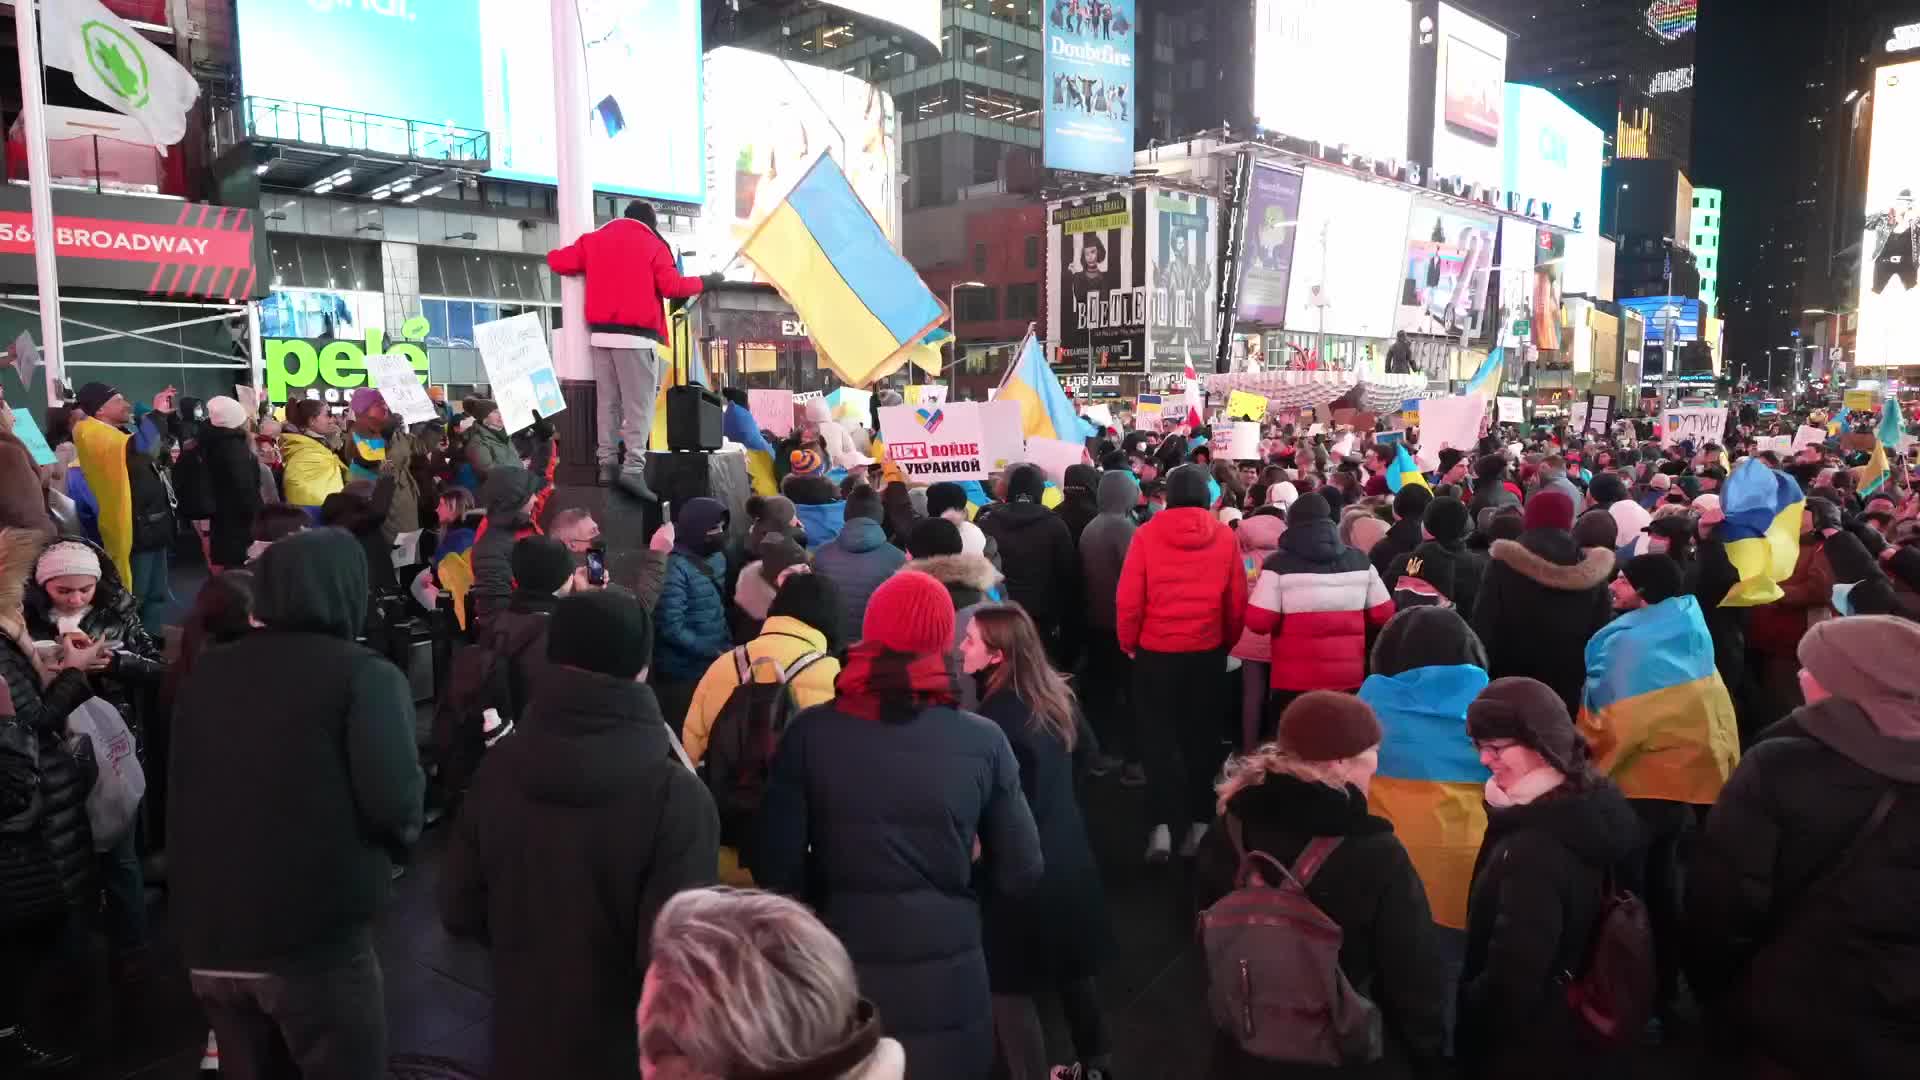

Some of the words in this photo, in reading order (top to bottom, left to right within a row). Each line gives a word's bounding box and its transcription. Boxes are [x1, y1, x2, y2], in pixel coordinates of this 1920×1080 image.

[0, 223, 34, 242] 56
[56, 227, 209, 255] BROADWAY
[889, 443, 926, 459] НЕТ
[931, 442, 979, 457] ВОЙНЕ
[904, 458, 981, 474] УКРАИНОЙ
